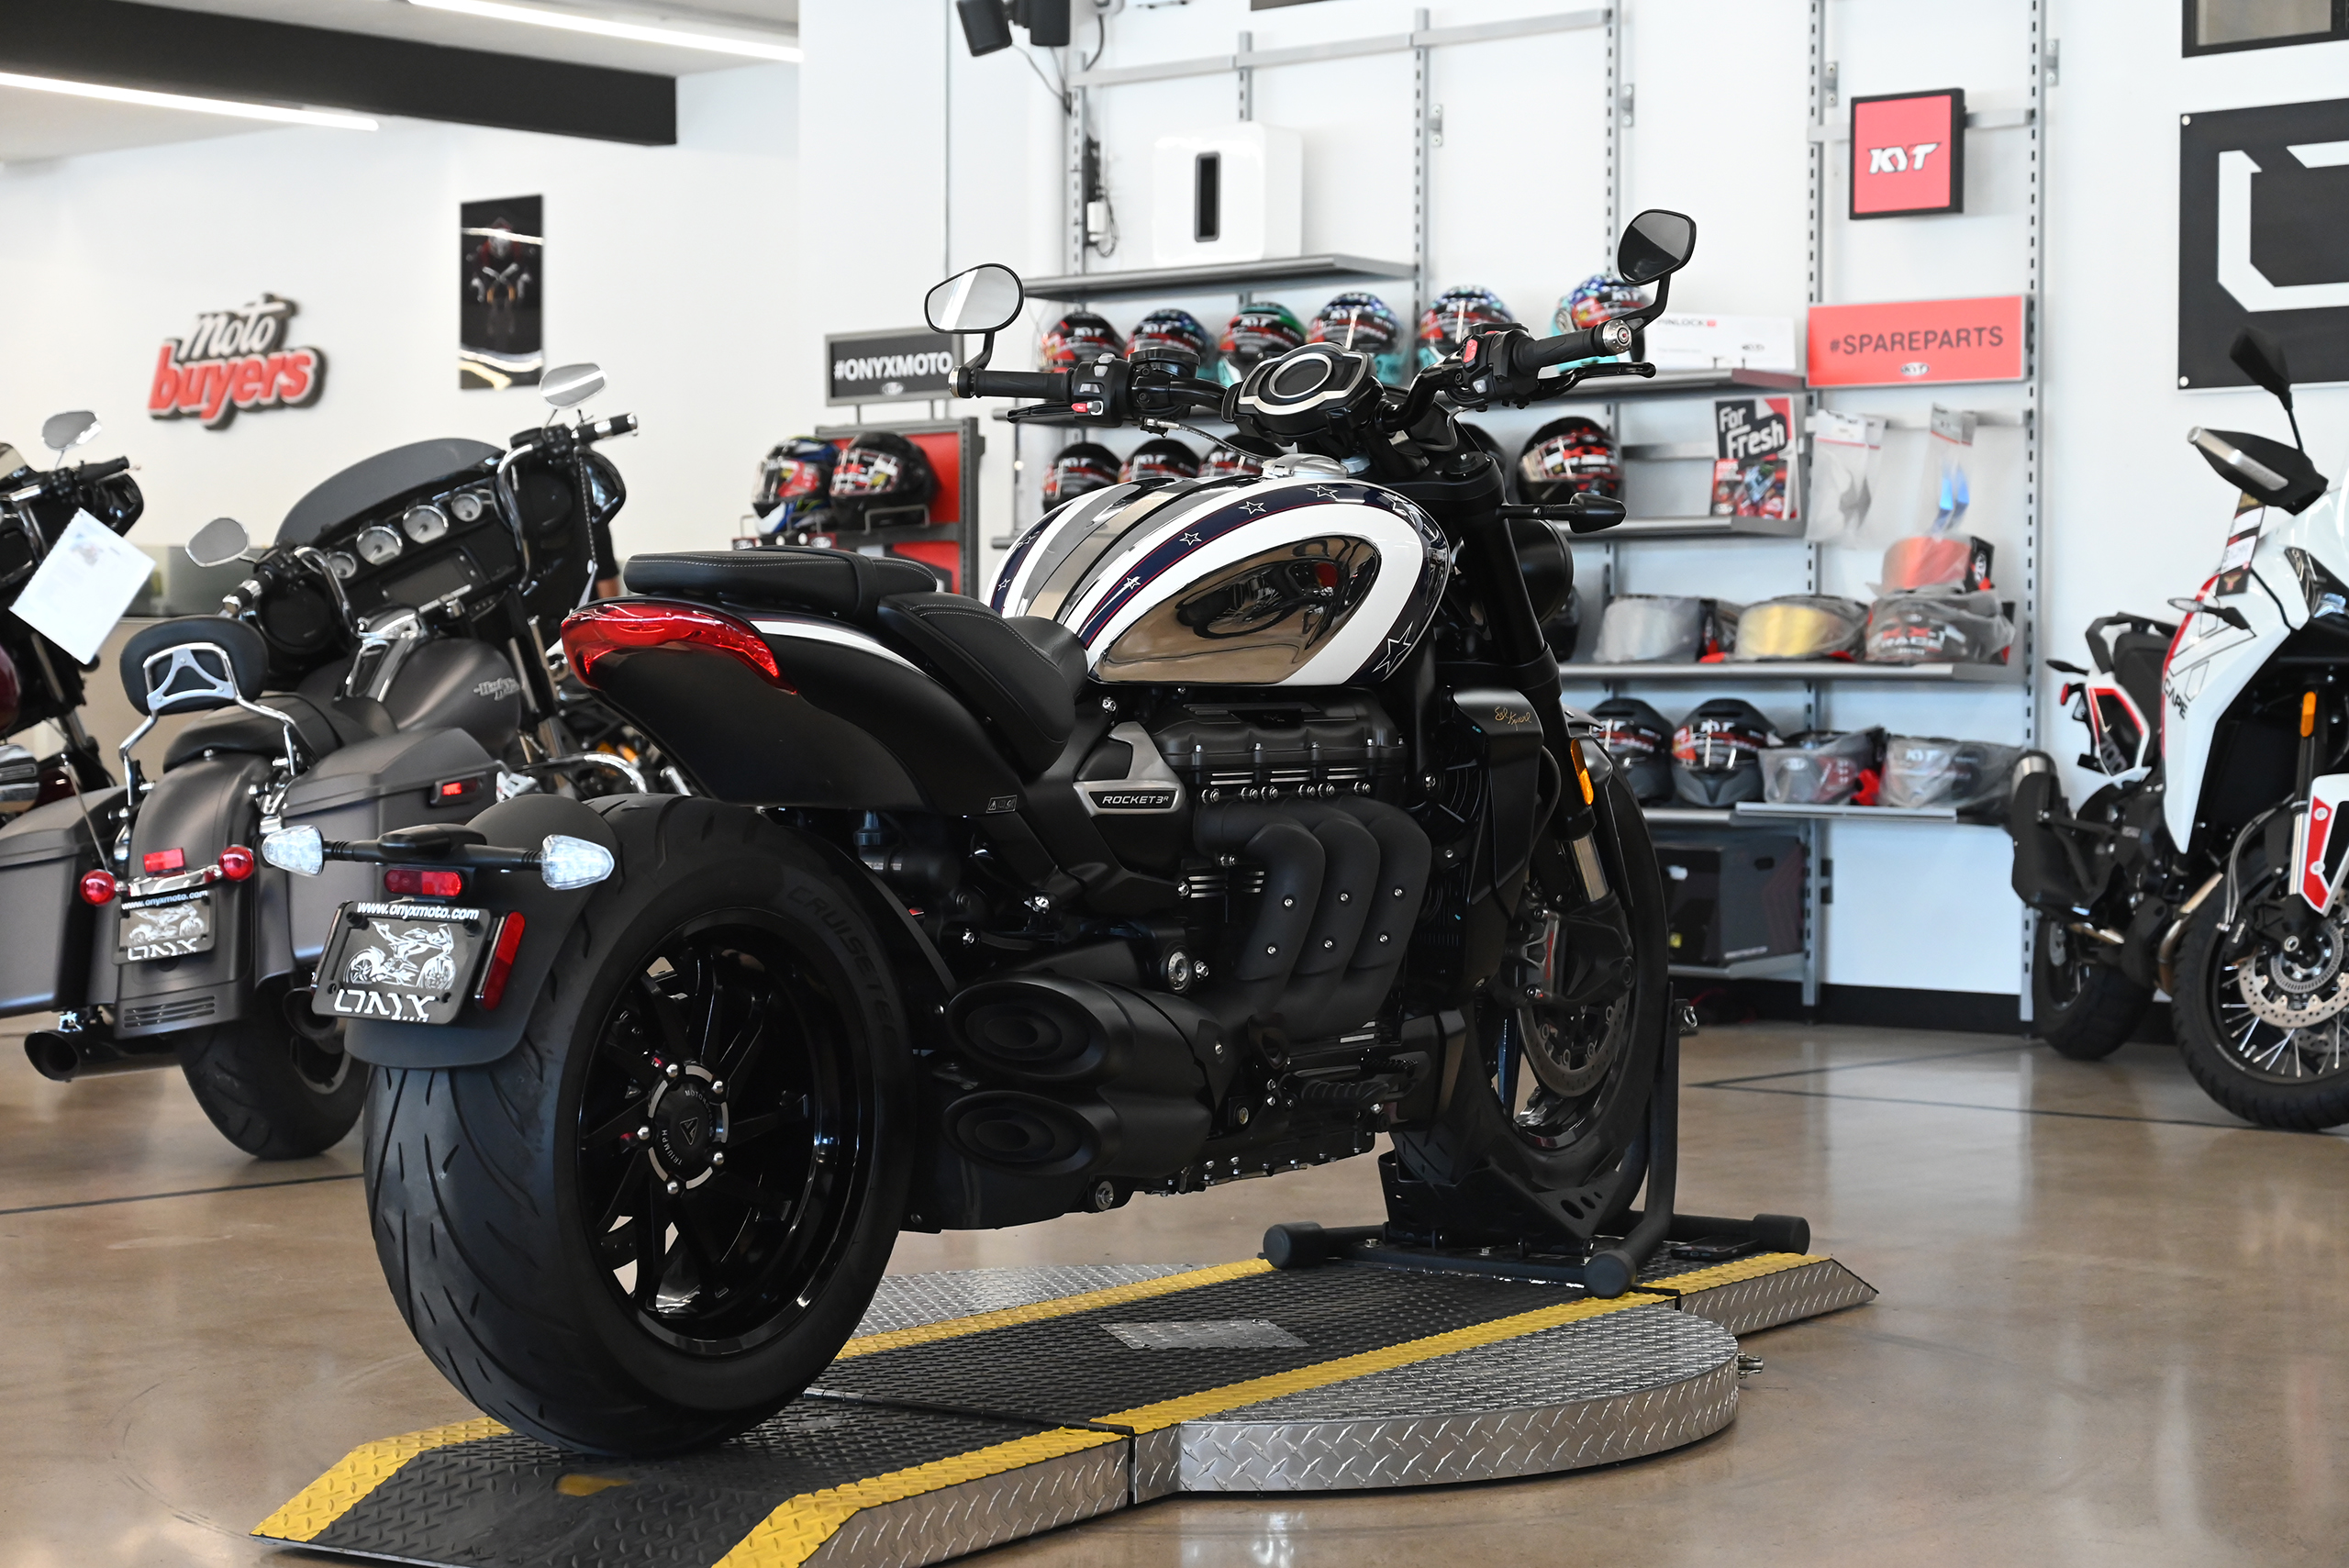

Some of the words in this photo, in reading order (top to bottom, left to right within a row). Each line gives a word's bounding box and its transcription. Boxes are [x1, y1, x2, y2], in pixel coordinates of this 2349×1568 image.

[1868, 142, 1941, 174] KYT
[1830, 326, 2004, 355] #SPAREPARTS
[833, 350, 954, 382] #ONYXMOTO
[148, 340, 317, 426] buyers
[1719, 406, 1747, 433] For
[1726, 419, 1786, 460] Fresh
[2163, 678, 2189, 720] CAPE
[121, 890, 208, 910] www.onyxmoto.com
[356, 902, 480, 920] www.onyxmoto.com
[661, 1129, 683, 1166] TRIUMPH
